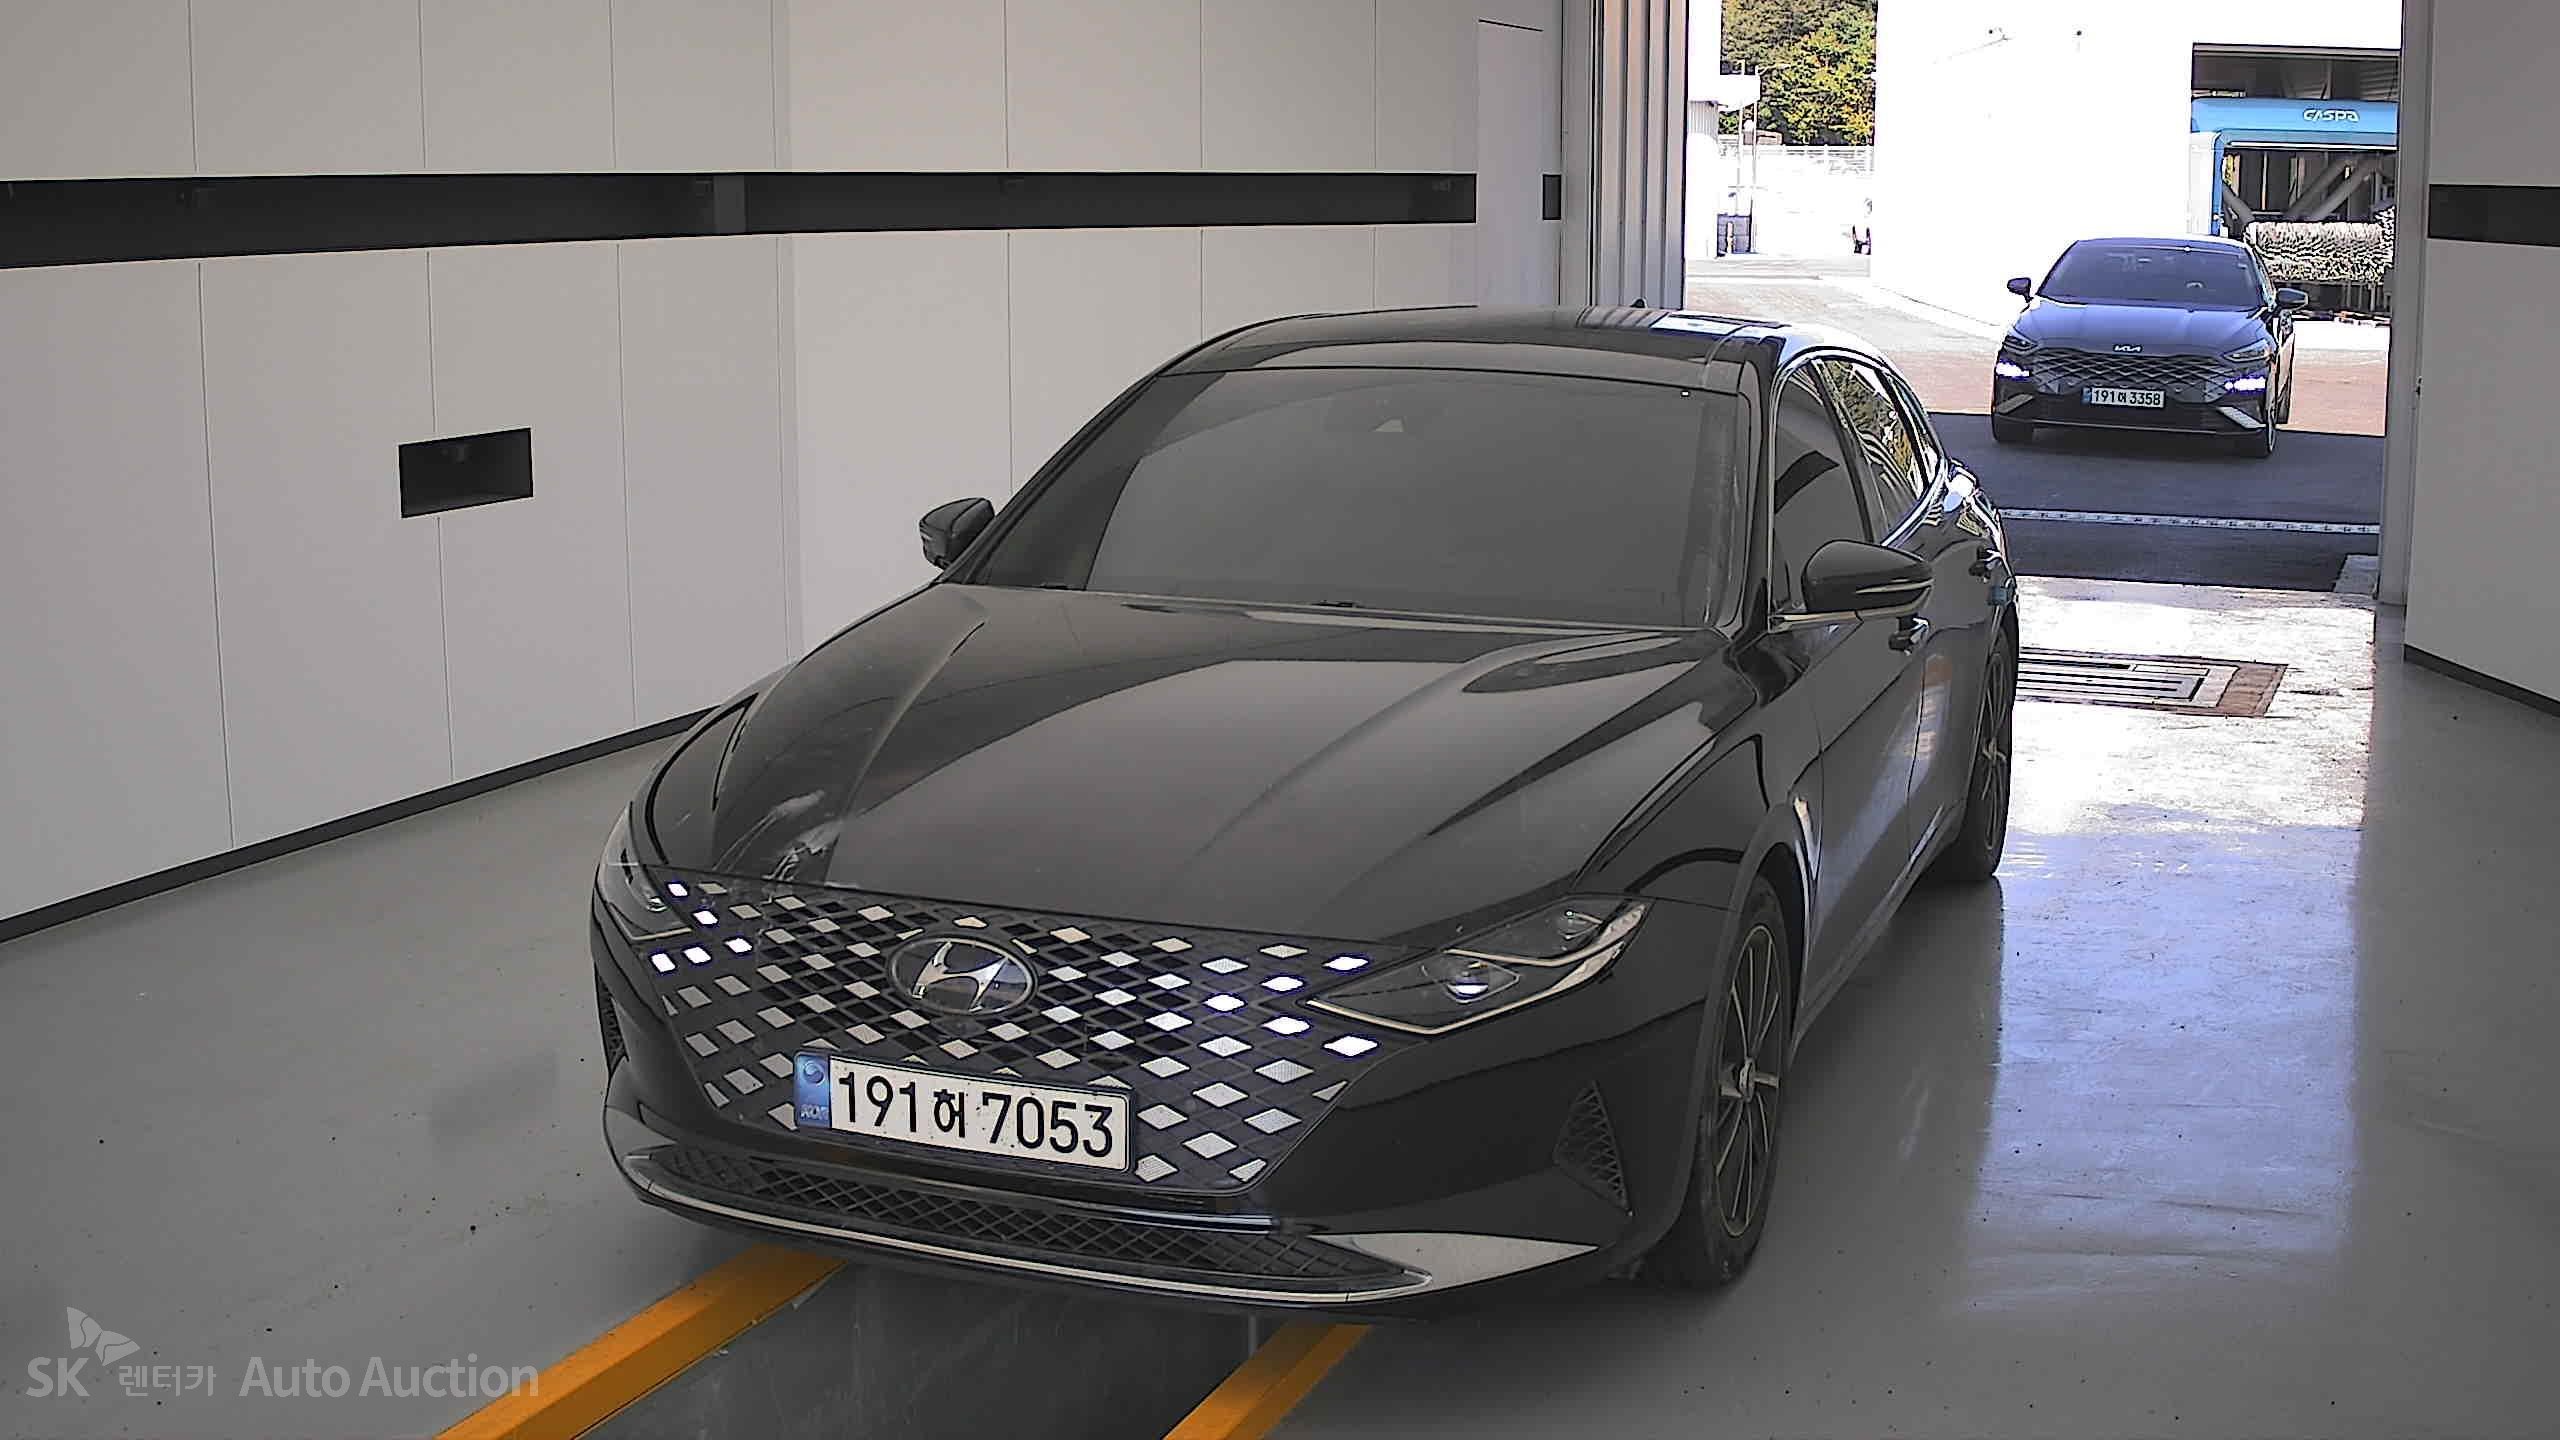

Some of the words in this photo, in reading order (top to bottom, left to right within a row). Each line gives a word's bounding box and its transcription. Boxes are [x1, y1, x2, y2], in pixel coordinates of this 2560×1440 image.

[2129, 391, 2161, 406] 3358
[838, 1071, 966, 1138] 191허
[982, 1091, 1113, 1158] 7053
